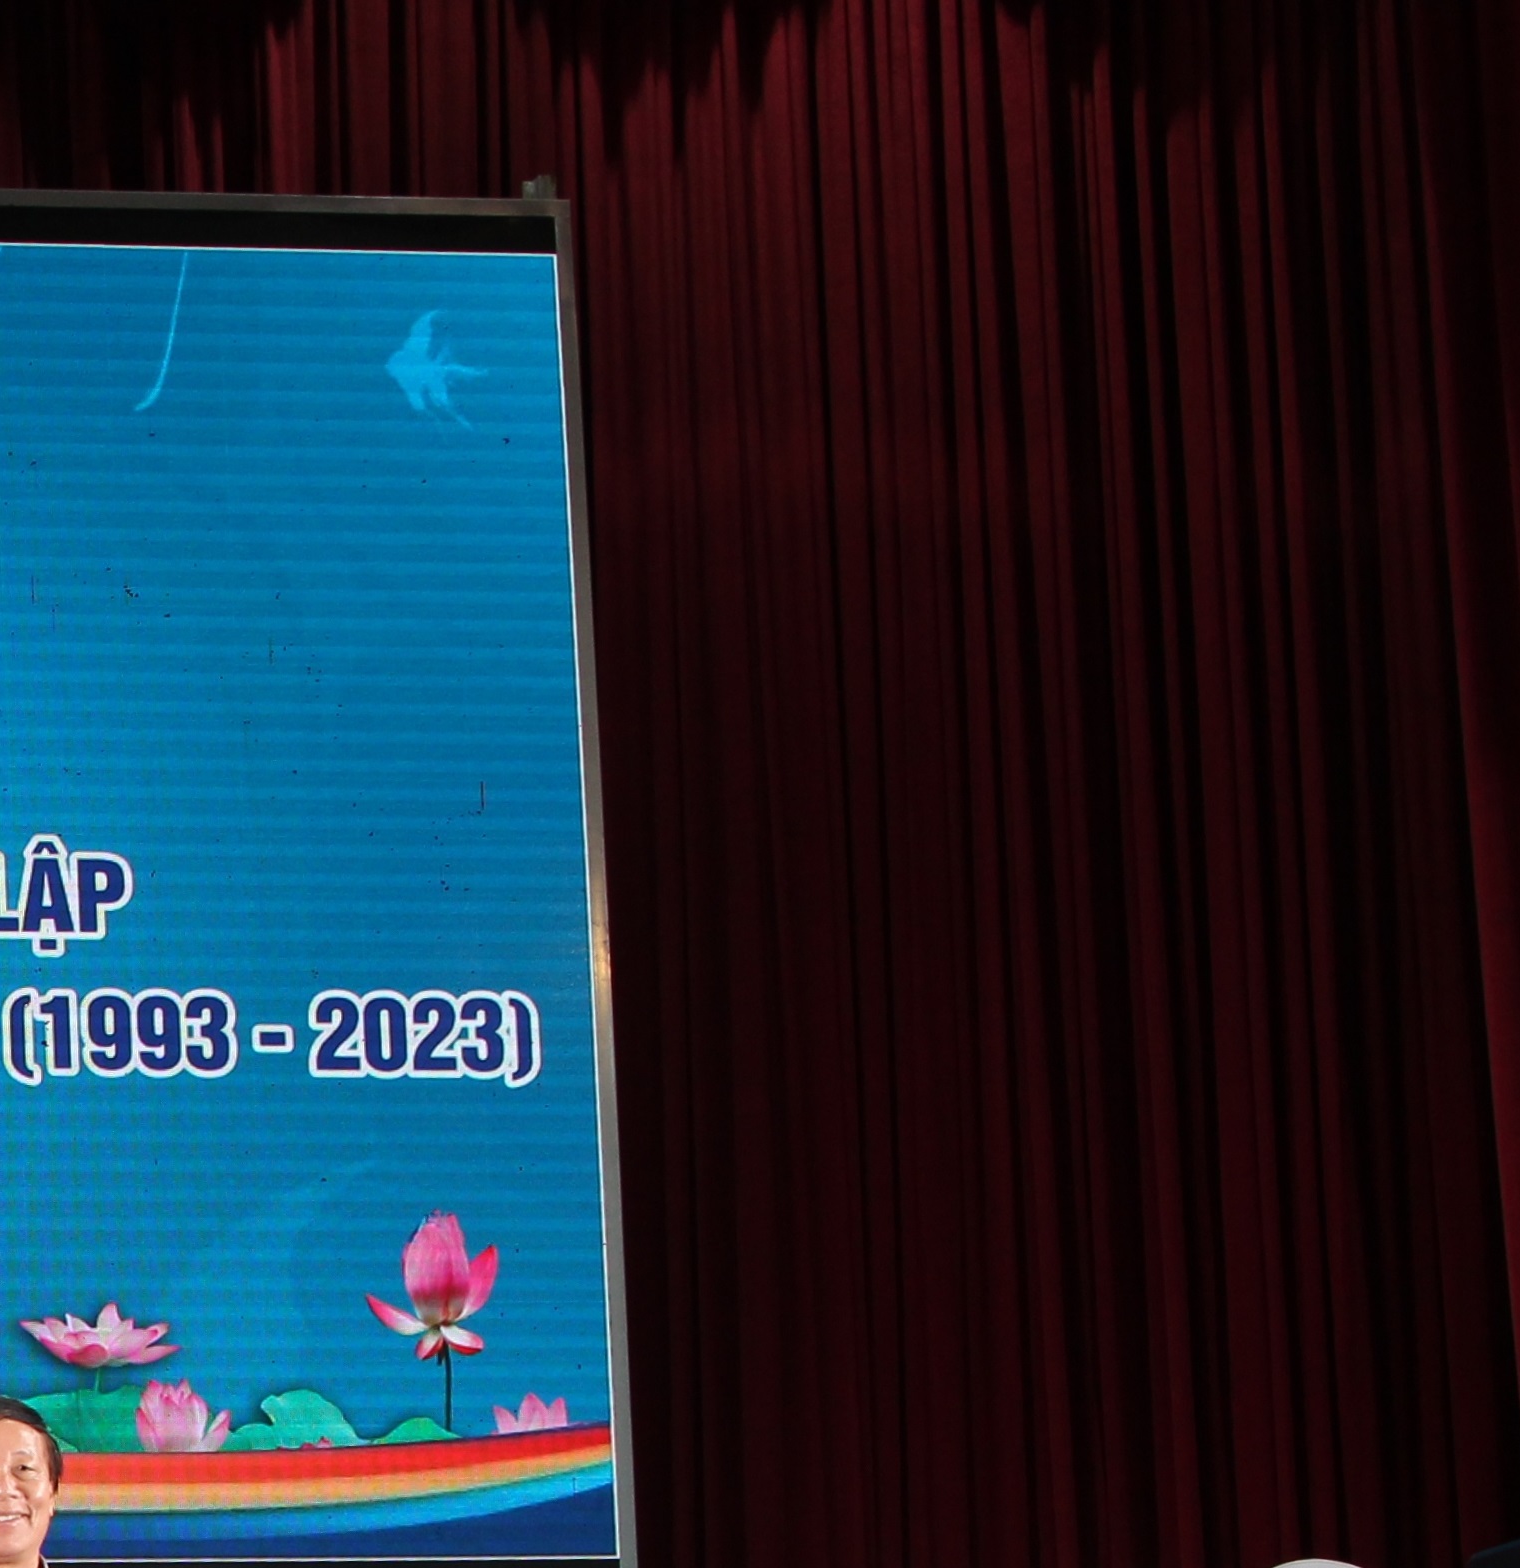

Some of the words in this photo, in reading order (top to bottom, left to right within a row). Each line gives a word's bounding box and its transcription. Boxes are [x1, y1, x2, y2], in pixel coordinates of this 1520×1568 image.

[9, 994, 231, 1080] (1993
[261, 1030, 286, 1046] -
[317, 995, 534, 1082] 2023)
